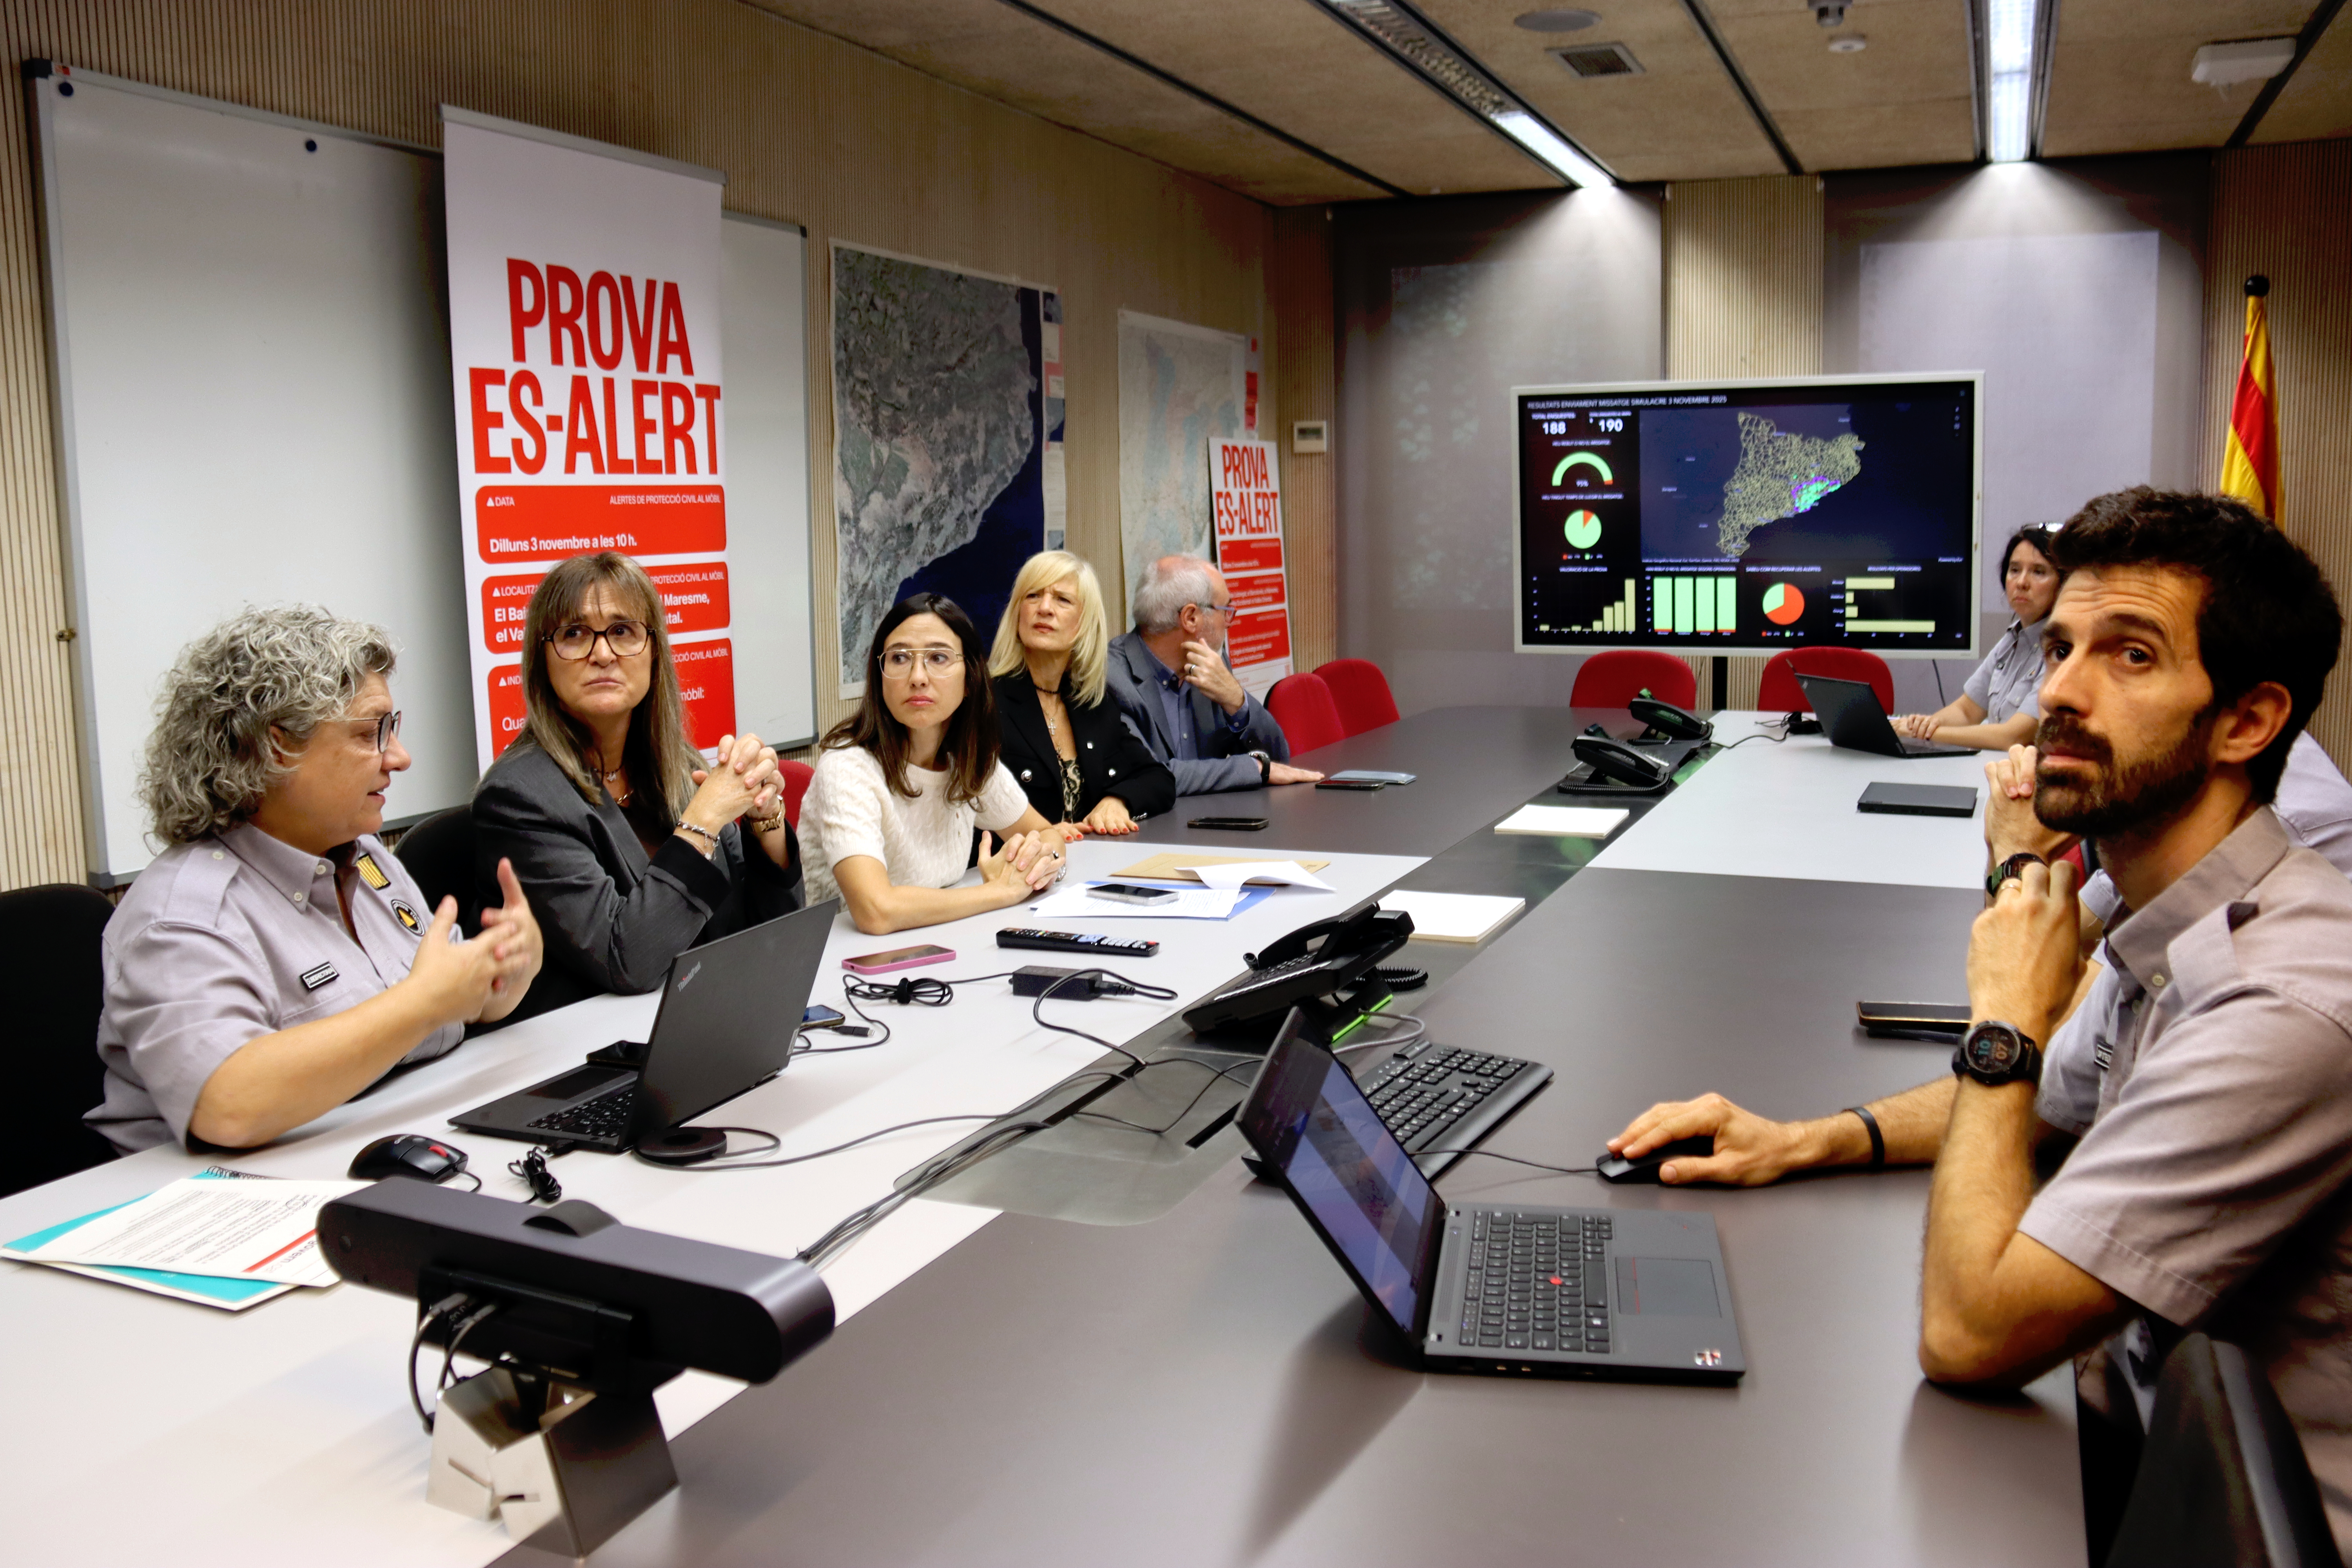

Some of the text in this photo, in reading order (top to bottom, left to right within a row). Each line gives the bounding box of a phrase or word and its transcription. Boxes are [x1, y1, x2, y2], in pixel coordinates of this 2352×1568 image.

[507, 258, 694, 376] PROVA
[1561, 399, 1598, 408] ENVIAMENT
[1599, 398, 1630, 407] MISSATGE
[1630, 397, 1667, 406] SIMULACRE
[1668, 396, 1673, 405] 3
[1673, 396, 1710, 405] NOVEMBRE
[469, 367, 720, 475] ES-ALERT
[1543, 421, 1566, 435] 188
[1599, 419, 1623, 432] 190
[1222, 445, 1269, 488] PROVA
[495, 496, 515, 506] DATA
[610, 495, 636, 505] ALERTES
[637, 495, 645, 504] DE
[646, 494, 681, 504] PROTECCIÓ
[682, 495, 697, 503] CIVIL
[697, 494, 705, 503] AL
[1216, 492, 1278, 535] ES-ALERT
[490, 533, 637, 553] Dilluns 3 novembre a les 10 h.
[686, 573, 701, 583] CIVIL
[701, 572, 709, 581] AL
[664, 593, 710, 606] Maresme,
[494, 608, 506, 622] El
[495, 628, 508, 643] el
[690, 651, 706, 661] CIVIL
[706, 650, 713, 659] AL
[507, 675, 522, 686] IND
[677, 961, 701, 992] ThinkPad
